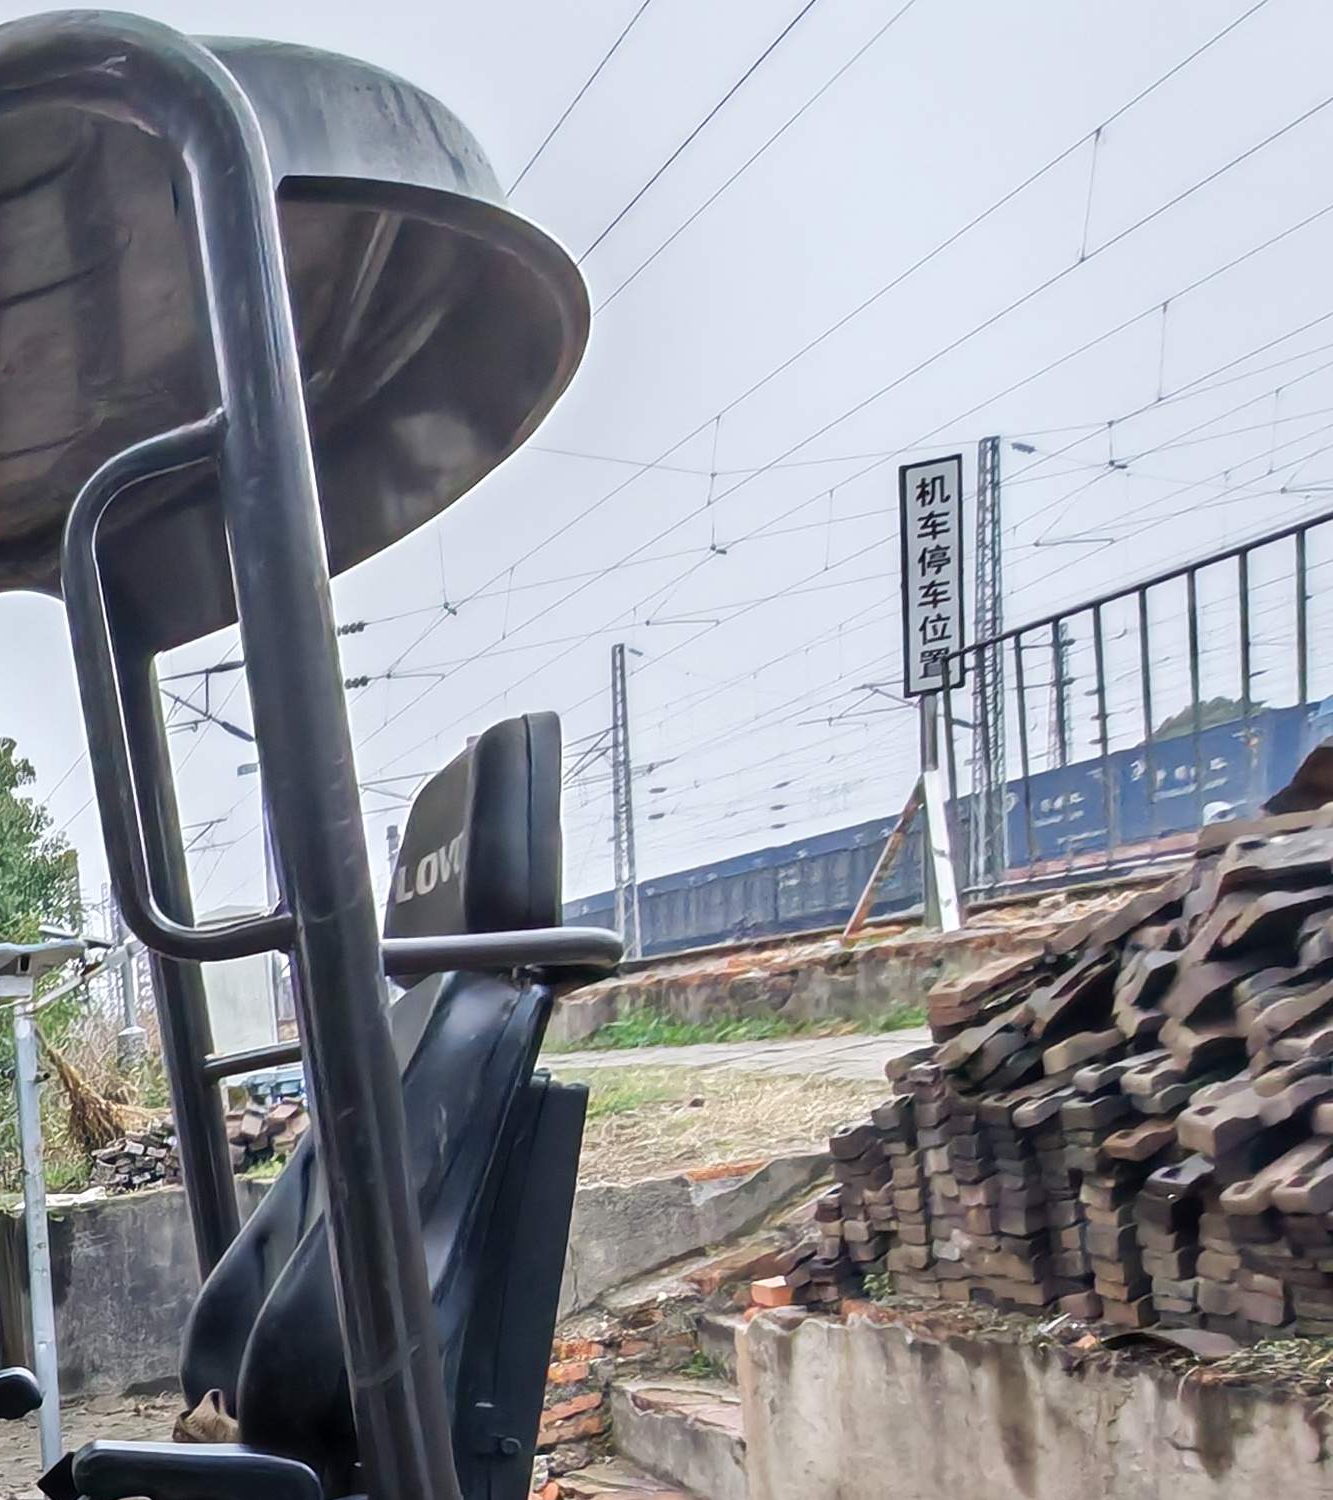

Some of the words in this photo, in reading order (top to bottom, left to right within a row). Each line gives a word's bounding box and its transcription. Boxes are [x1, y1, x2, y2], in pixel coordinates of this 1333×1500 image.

[915, 474, 952, 681] 机车停车位置
